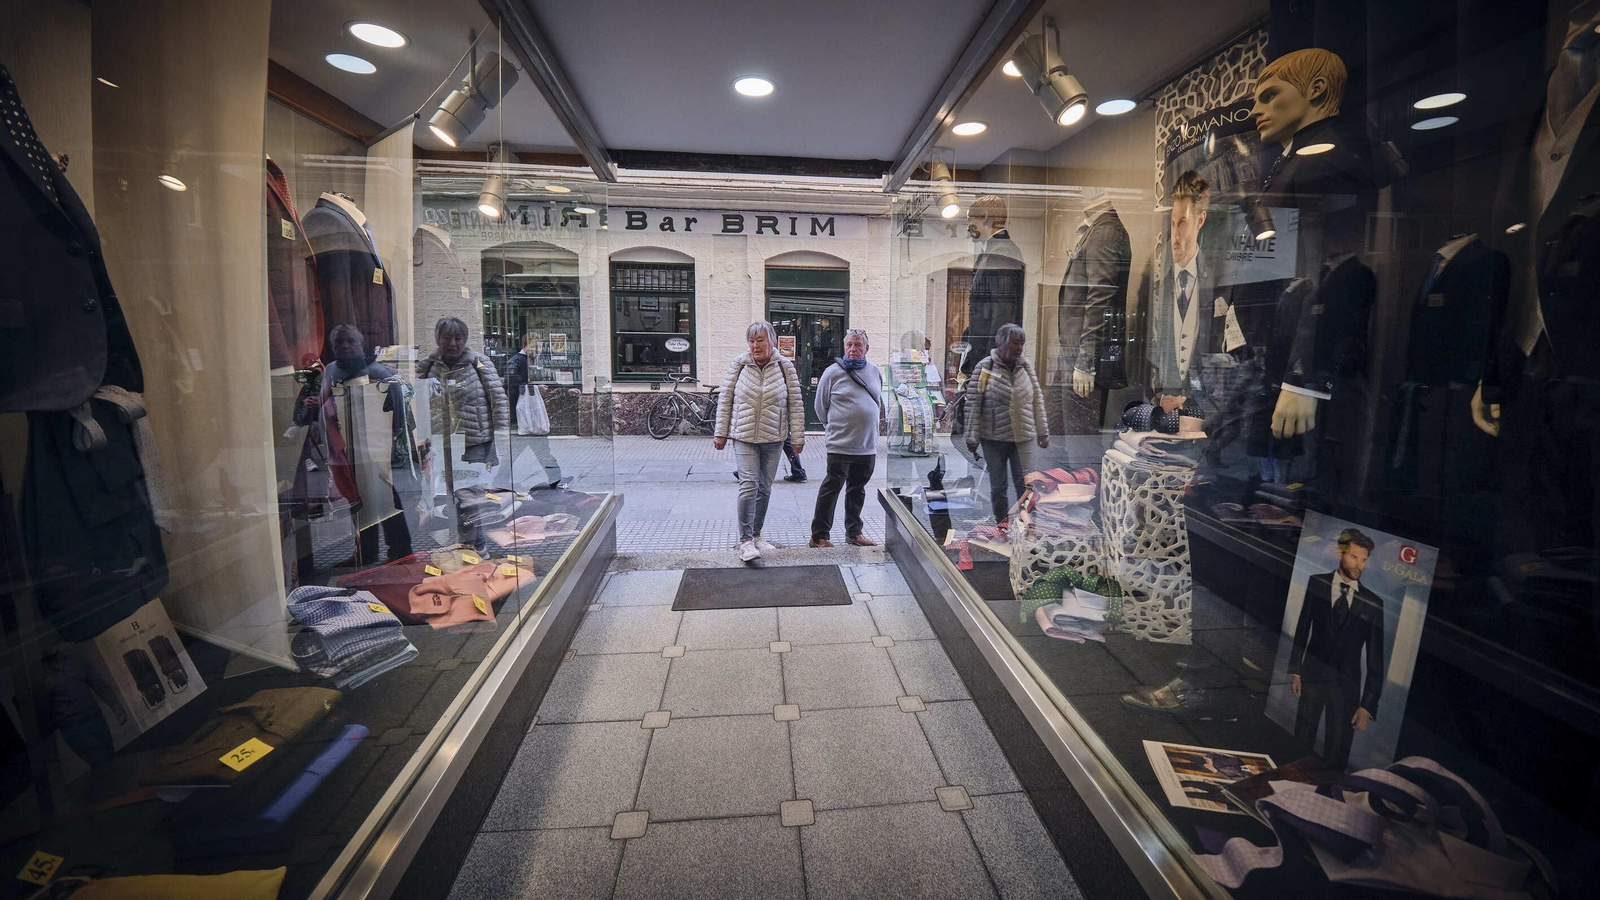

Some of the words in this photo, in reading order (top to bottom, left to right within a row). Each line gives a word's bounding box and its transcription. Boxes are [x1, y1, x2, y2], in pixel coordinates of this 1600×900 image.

[625, 210, 698, 232] Bar
[721, 213, 835, 236] BRIM
[1400, 546, 1417, 564] G
[131, 621, 140, 631] B
